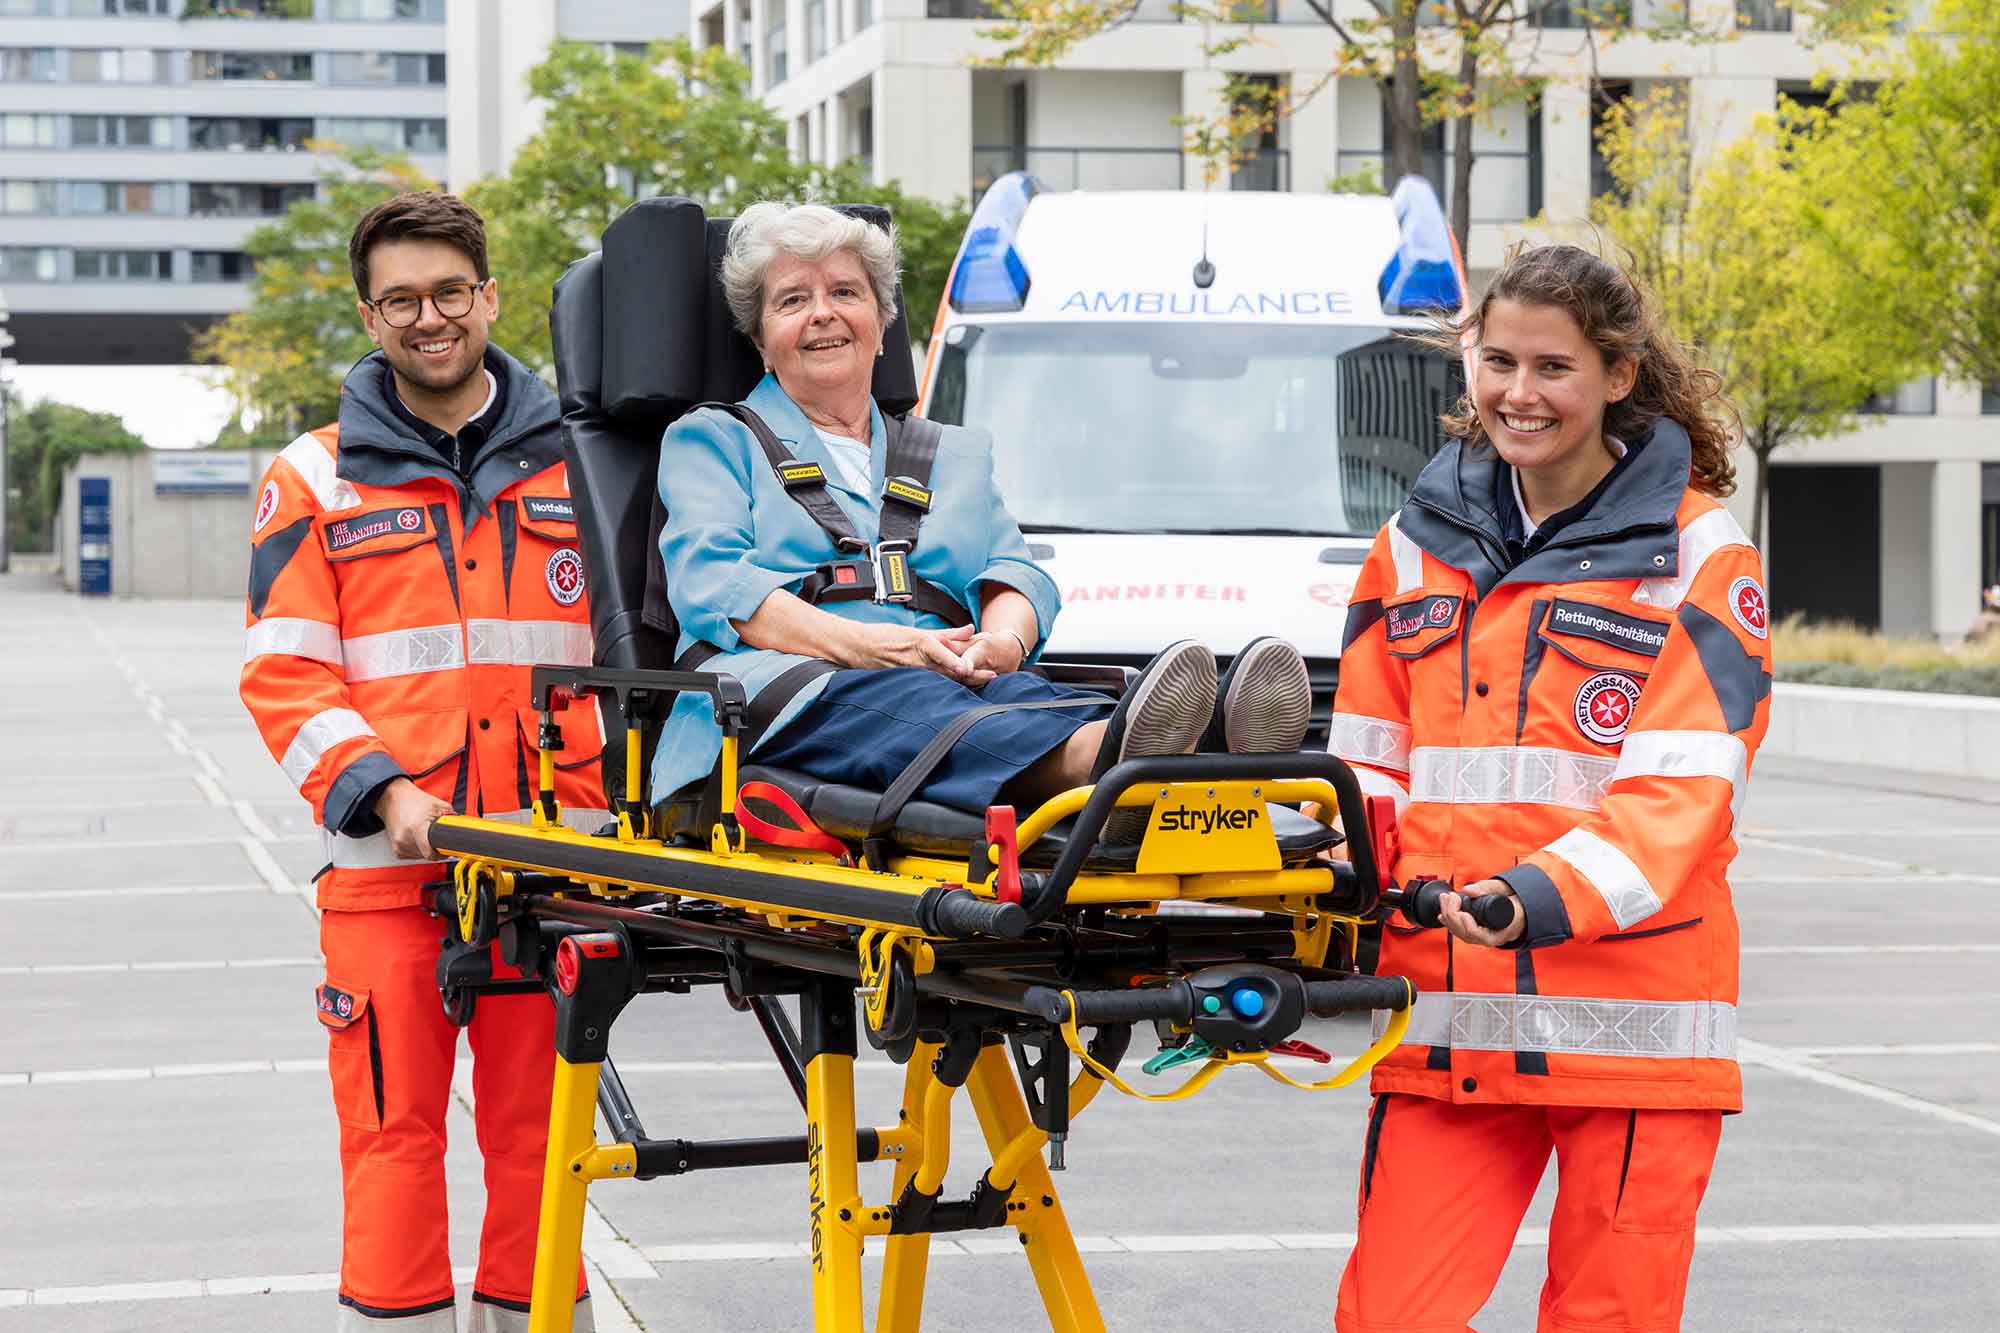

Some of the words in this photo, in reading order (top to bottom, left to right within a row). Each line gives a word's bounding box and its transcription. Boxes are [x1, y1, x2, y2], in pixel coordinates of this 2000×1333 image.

[1060, 291, 1352, 314] AMBULANCE
[332, 523, 348, 536] DIE
[333, 521, 392, 546] JOHANNITER
[1060, 584, 1246, 603] ANNITER
[1556, 609, 1665, 646] Rettungssanitäterin
[1159, 804, 1259, 834] stryker
[807, 1121, 826, 1273] stryker
